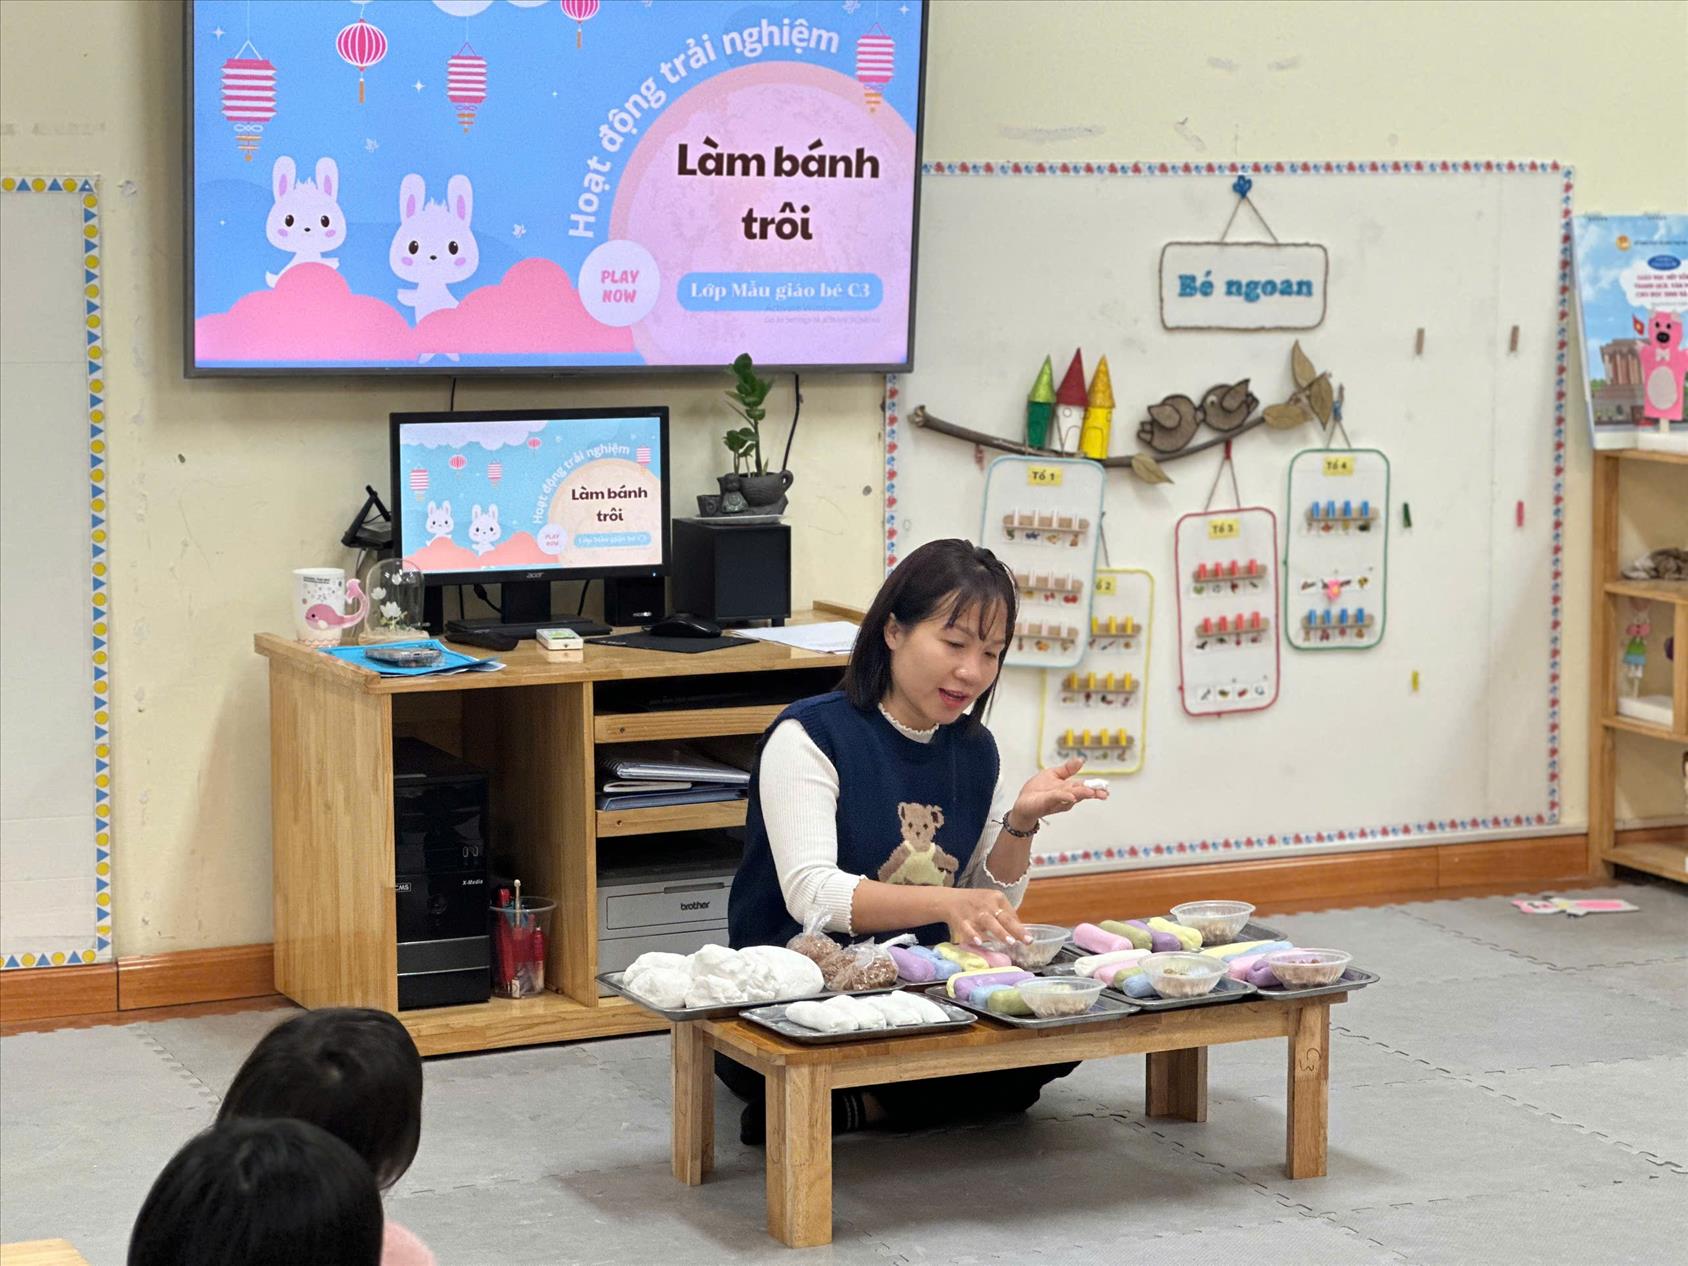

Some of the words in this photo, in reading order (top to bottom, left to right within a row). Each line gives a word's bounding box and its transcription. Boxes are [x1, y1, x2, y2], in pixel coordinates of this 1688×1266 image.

[568, 156, 611, 238] Hoạt
[599, 76, 667, 152] động
[659, 34, 717, 83] trải
[722, 18, 840, 58] nghiệm
[677, 136, 766, 177] Làm
[773, 138, 880, 178] bánh
[741, 202, 813, 240] trôi
[600, 270, 640, 284] PLAY
[691, 282, 727, 301] Lớp
[775, 282, 815, 300] giáo
[820, 282, 843, 297] bé
[847, 282, 871, 297] C3
[1178, 270, 1214, 297] Bé
[1225, 279, 1313, 303] ngoan
[602, 289, 637, 303] NOW
[572, 486, 605, 501] Làm
[607, 484, 648, 500] bánh
[596, 507, 624, 522] trôi
[680, 901, 711, 911] brother
